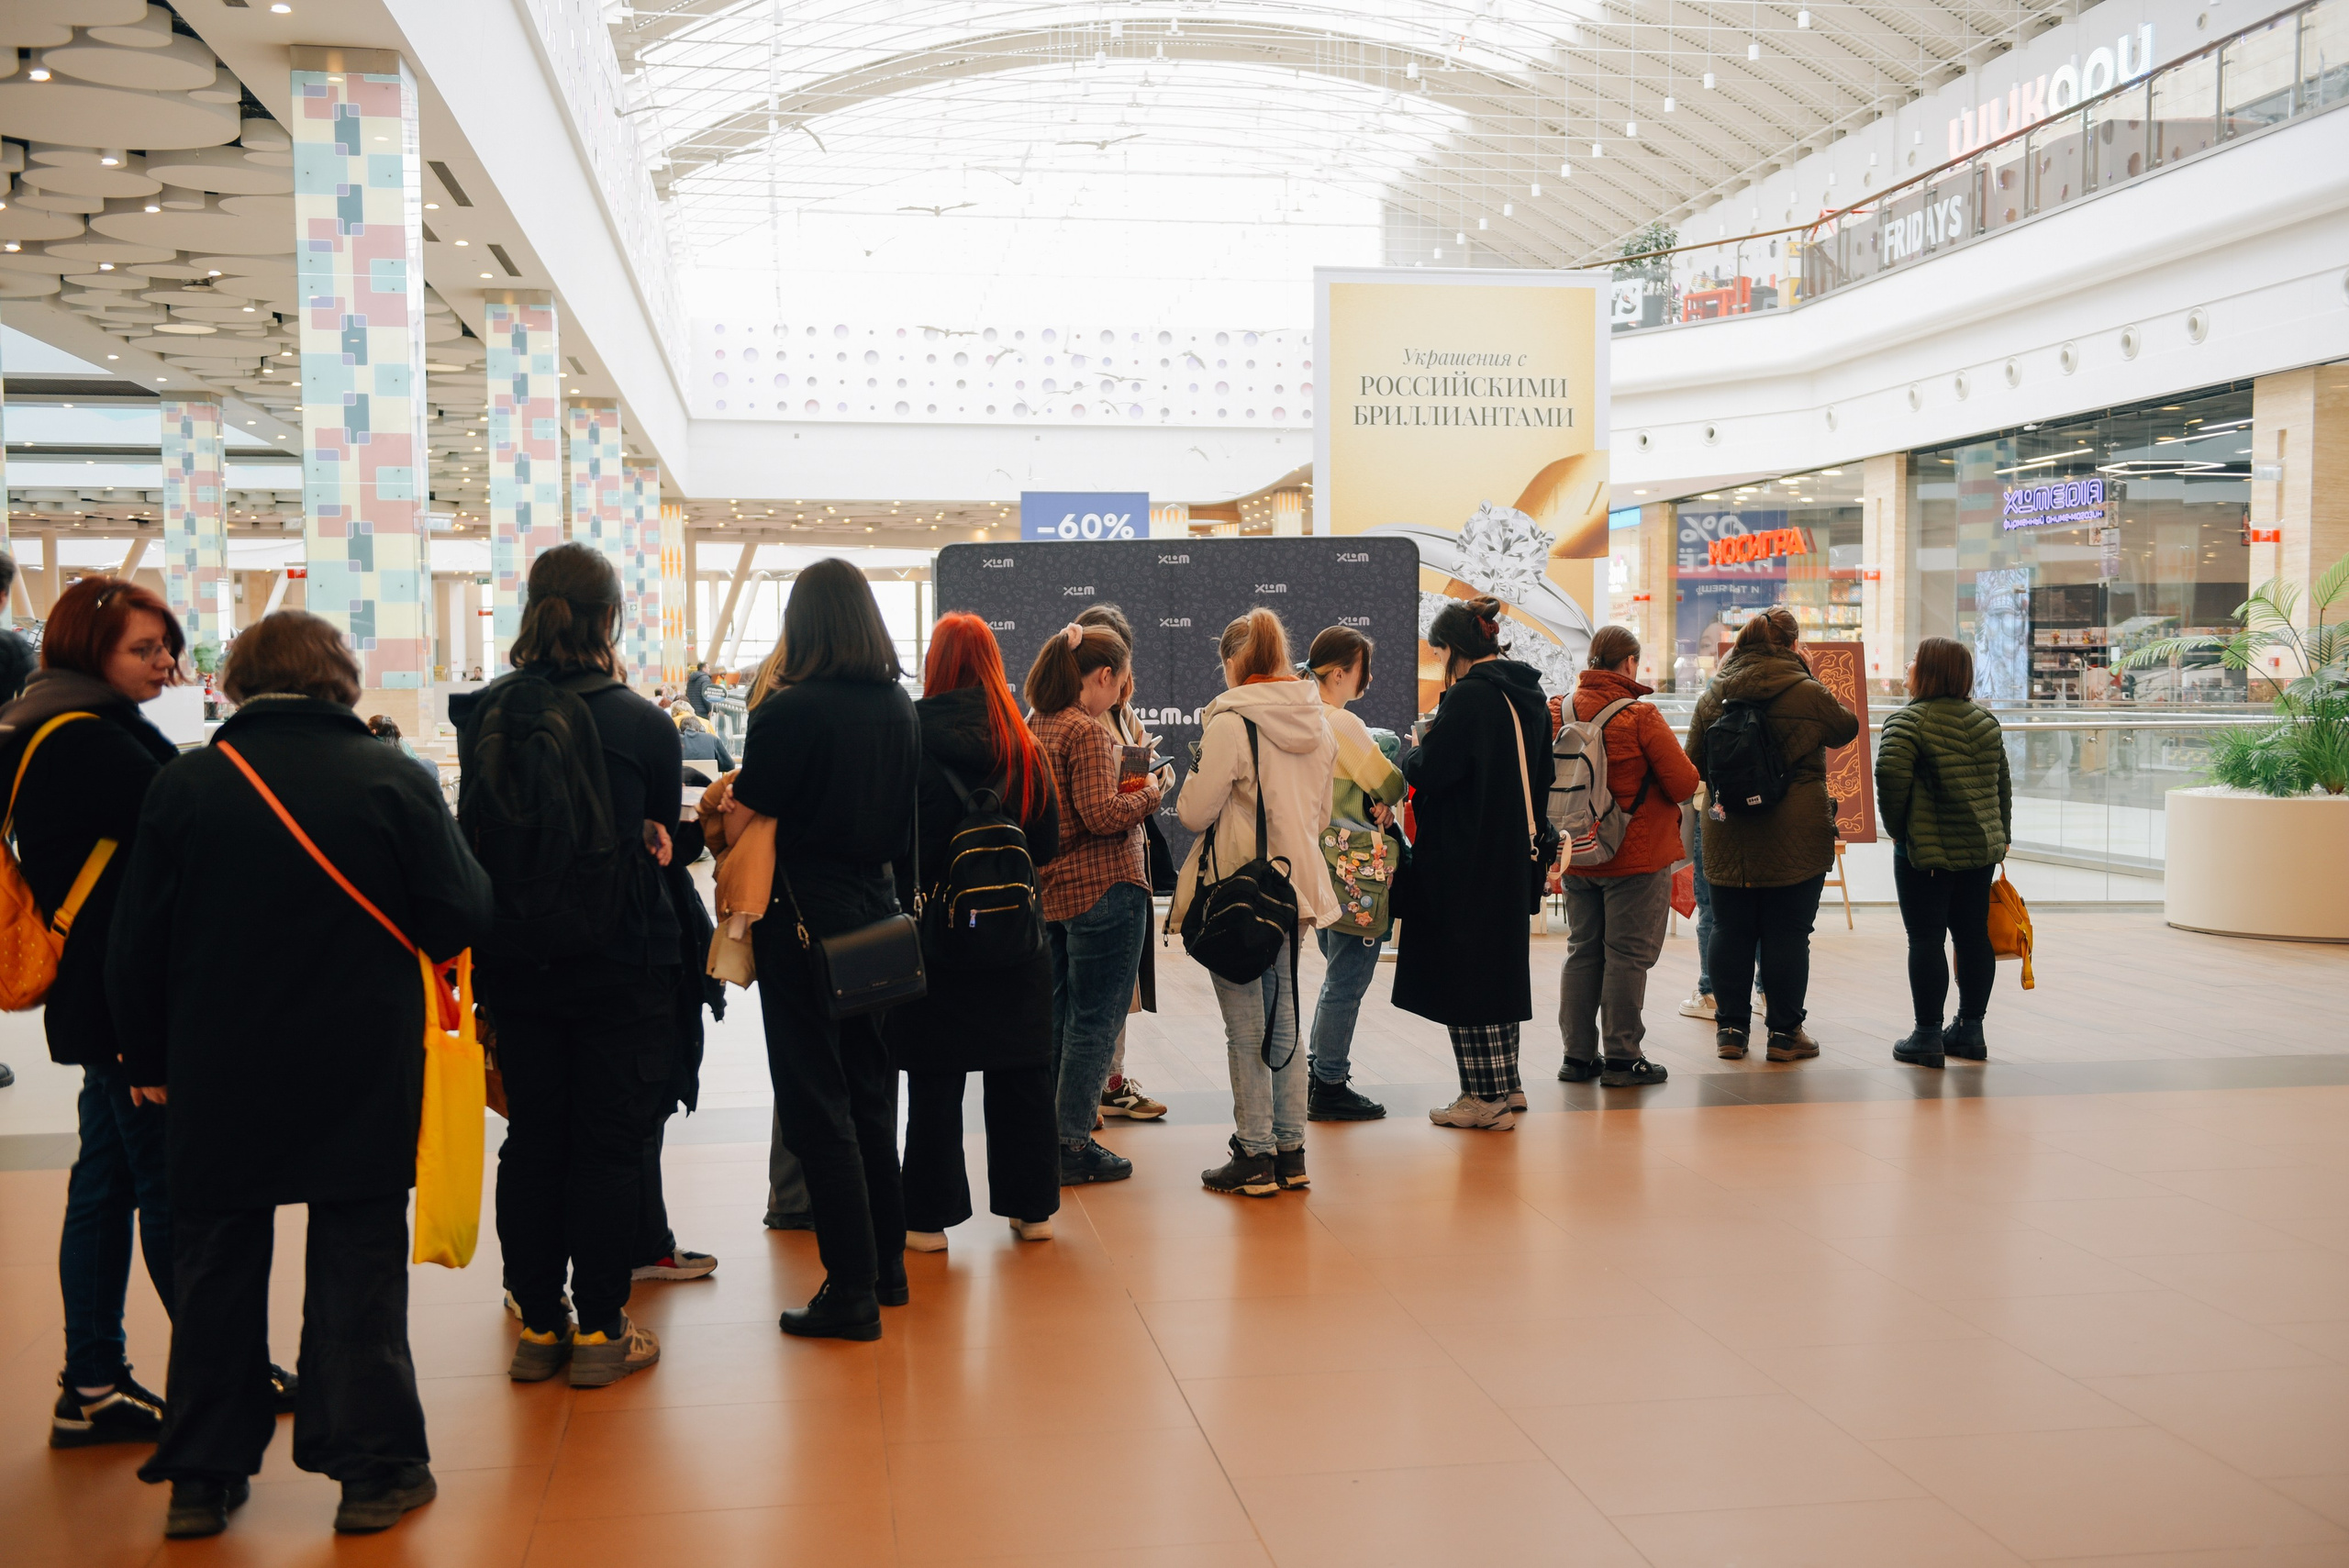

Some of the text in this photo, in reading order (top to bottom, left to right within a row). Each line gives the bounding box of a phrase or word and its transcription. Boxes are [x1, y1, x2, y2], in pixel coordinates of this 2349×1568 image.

[1884, 195, 1963, 263] FRIDAYS
[1402, 348, 1528, 369] Украшения с
[1359, 371, 1568, 398] РОССИЙСКИМИ
[1353, 405, 1575, 428] БРИЛЛИАНТАМИ
[1037, 513, 1135, 539] -60%
[1708, 526, 1808, 565] МОСИГРА
